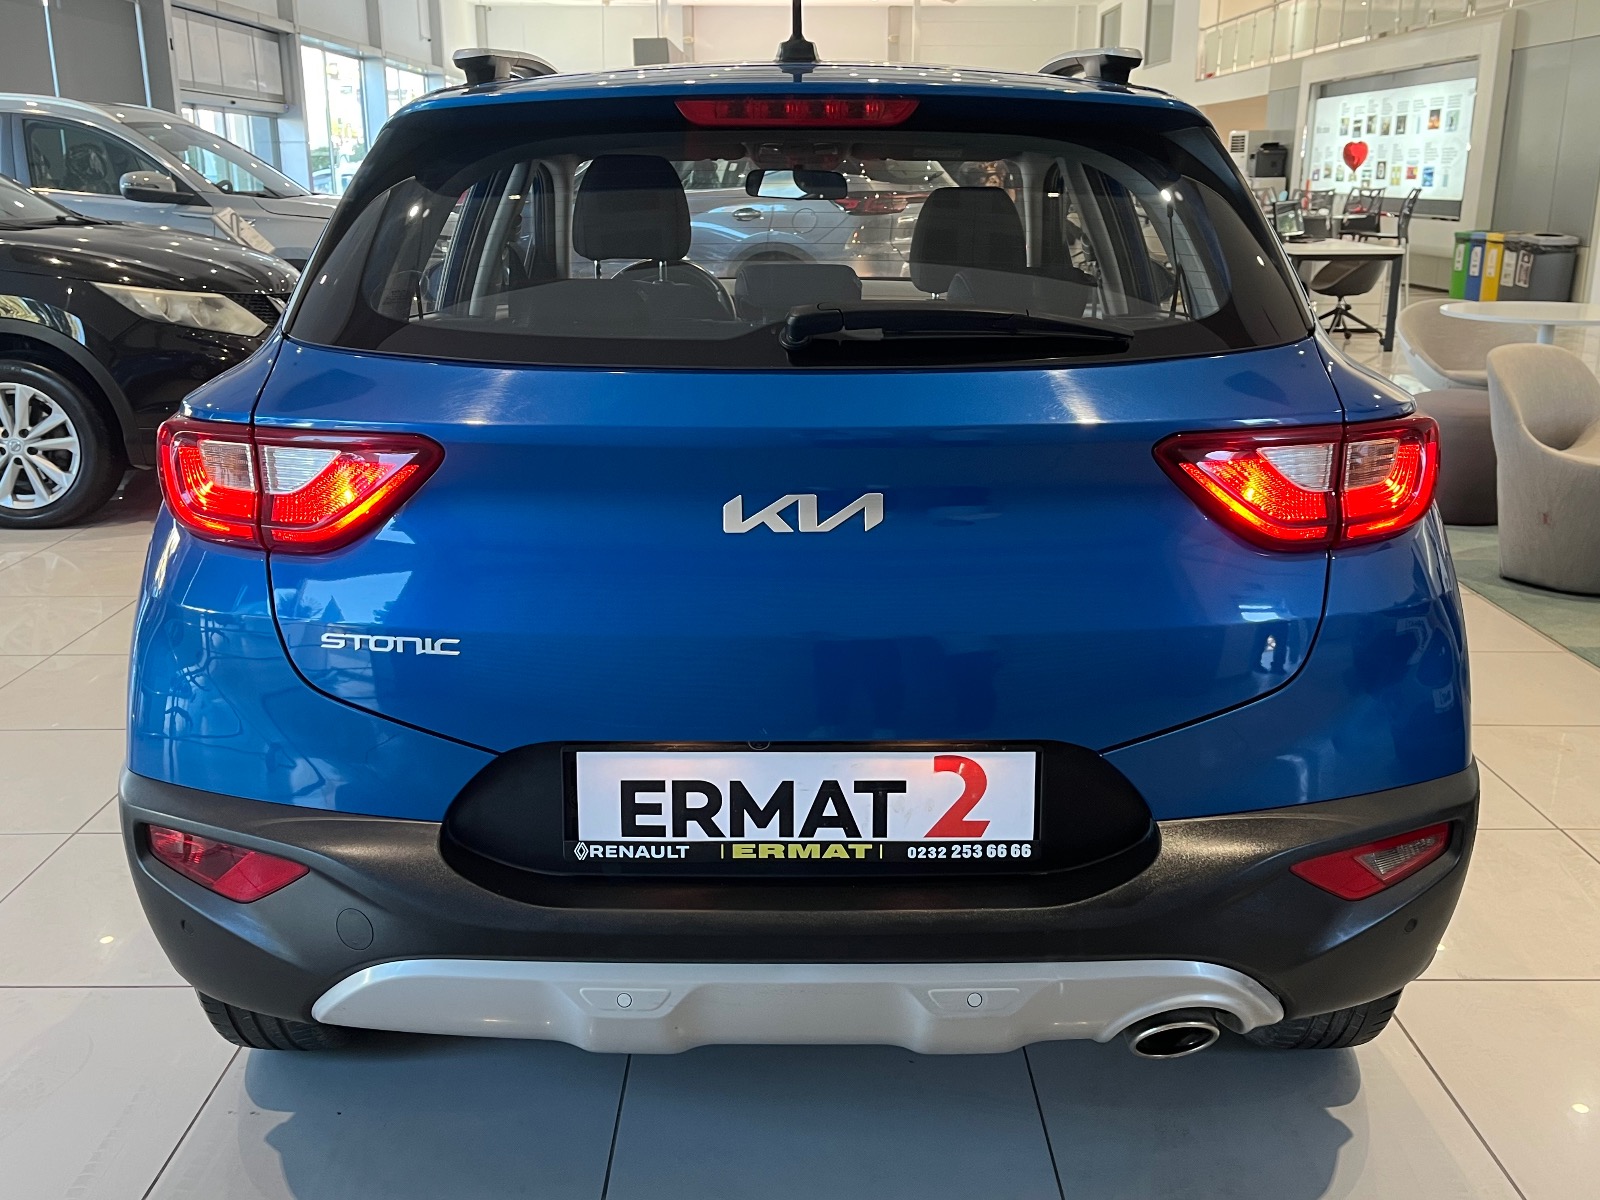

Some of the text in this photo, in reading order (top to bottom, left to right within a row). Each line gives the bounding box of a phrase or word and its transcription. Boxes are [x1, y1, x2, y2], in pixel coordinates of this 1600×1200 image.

[723, 493, 884, 533] KIA
[320, 633, 461, 656] STONIC
[621, 754, 990, 838] ERMAT 2
[590, 845, 690, 859] RENAULT
[733, 844, 873, 859] ERMAT
[908, 844, 1032, 859] 0232 253 66 66
